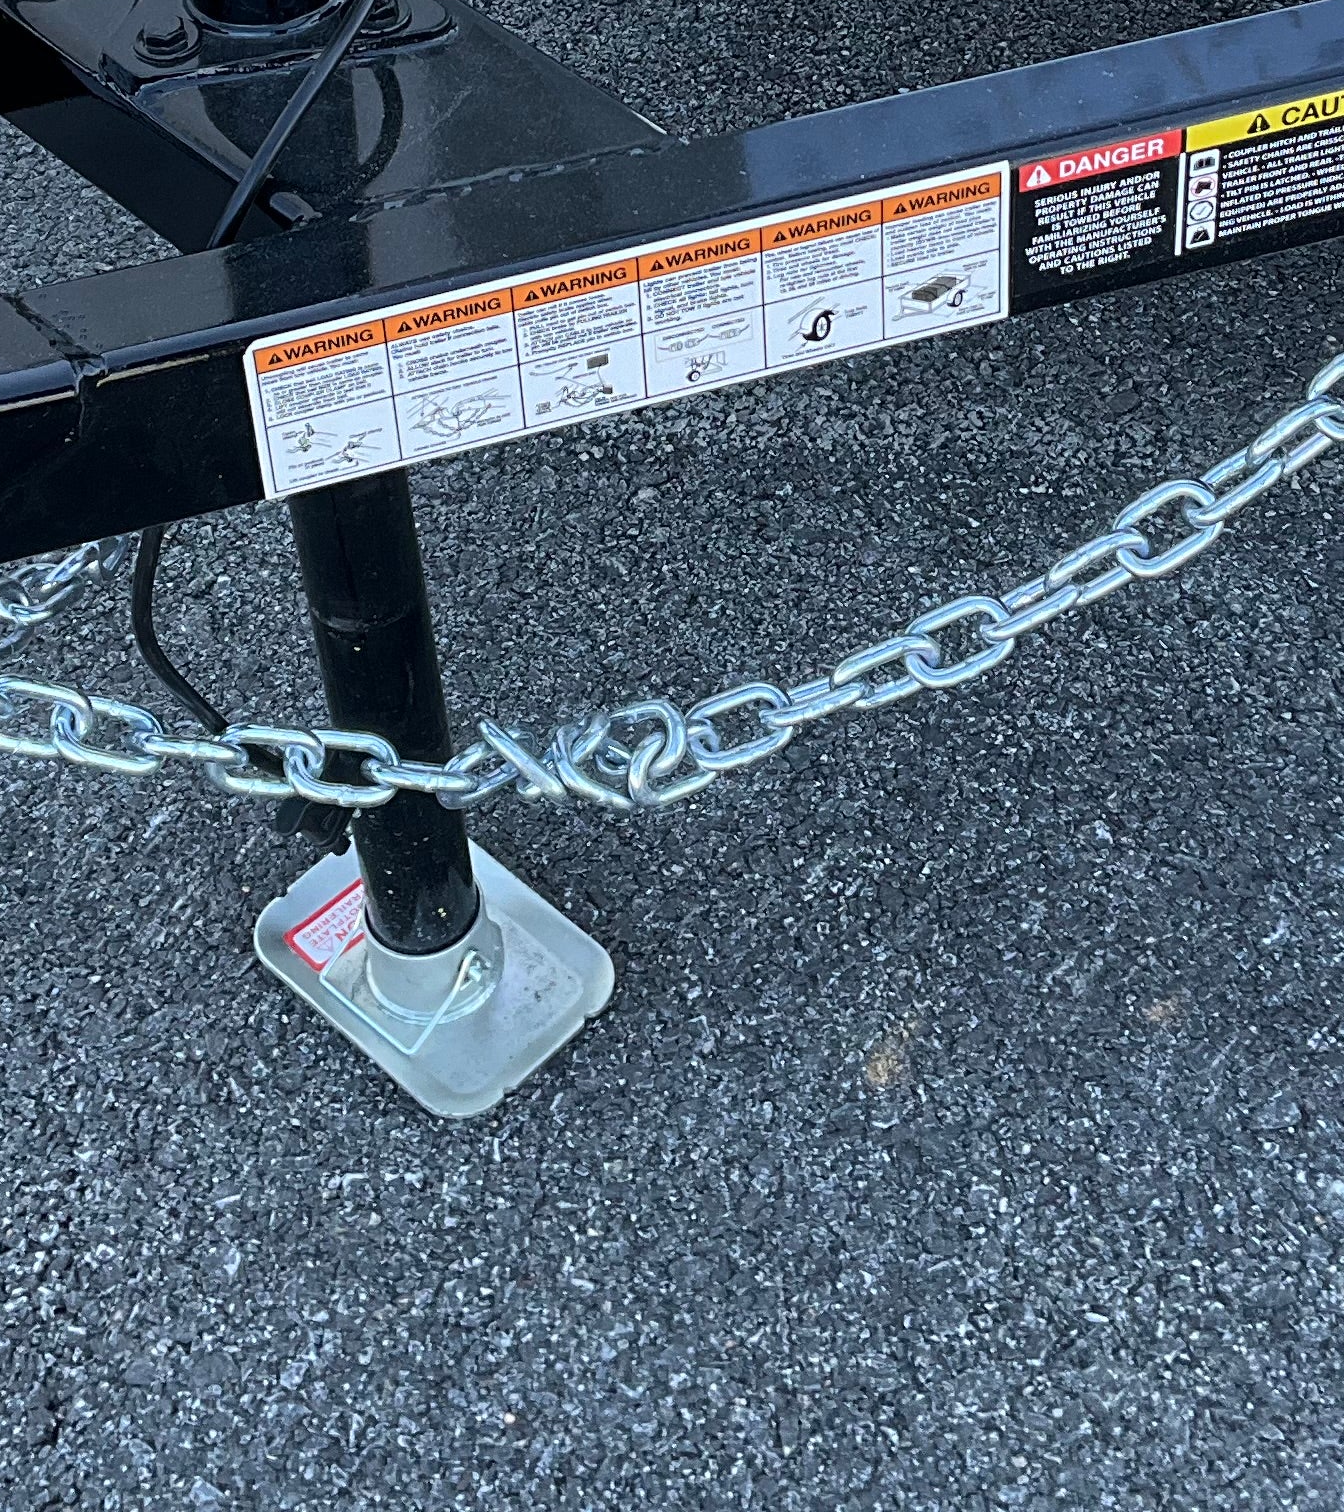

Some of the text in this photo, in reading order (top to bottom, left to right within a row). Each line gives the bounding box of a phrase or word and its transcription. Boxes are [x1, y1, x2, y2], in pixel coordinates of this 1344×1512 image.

[1059, 139, 1164, 177] DANGER
[909, 182, 990, 210] WARNING
[1034, 170, 1160, 208] SERIOUS INJURY AND/OR
[1034, 180, 1159, 217] PROPERTY DAMAGE CAN
[1037, 190, 1156, 225] RESULT IF THIS VEHICLE
[1051, 202, 1141, 231] IS TOWED BEFORE
[789, 210, 871, 238] WARNING
[1031, 206, 1160, 245] FAMILIARIZING YOURSELF
[666, 238, 750, 267] WARNING
[1024, 242, 1051, 256] WITH
[1054, 237, 1073, 249] THE
[1028, 224, 1161, 264] OPERATING INSTRUCTIONS
[1038, 236, 1151, 270] AND CAUTIONS LISTED
[1060, 264, 1074, 274] TO
[1075, 258, 1095, 271] THE
[540, 268, 627, 297] WARNING
[413, 297, 501, 328] WARNING
[284, 329, 374, 360] WARNING
